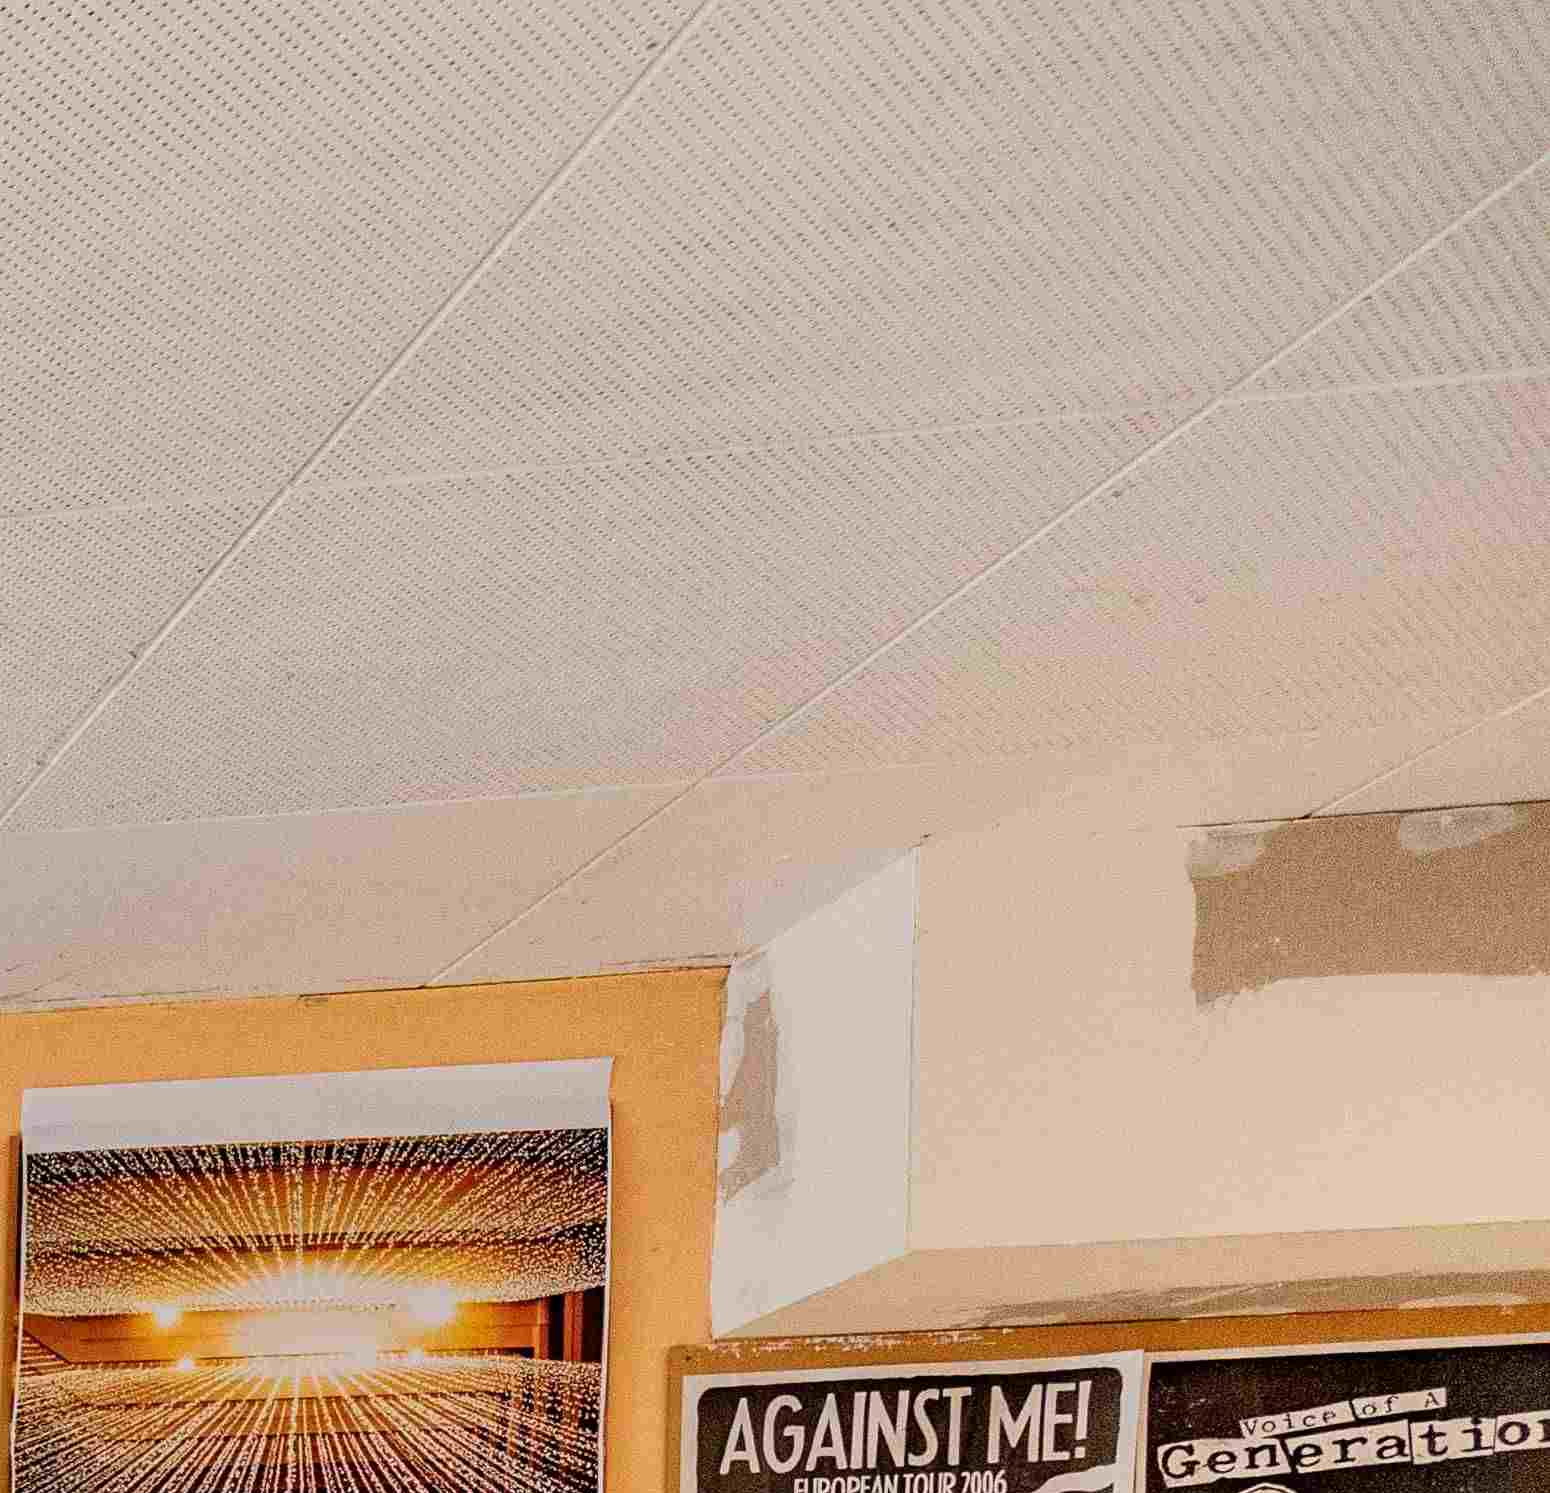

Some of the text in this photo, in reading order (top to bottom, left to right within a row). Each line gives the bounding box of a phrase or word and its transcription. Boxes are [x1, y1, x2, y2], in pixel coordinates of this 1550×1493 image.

[719, 1379, 1093, 1478] AGAINST ME!
[1245, 1392, 1439, 1434] Voice of A
